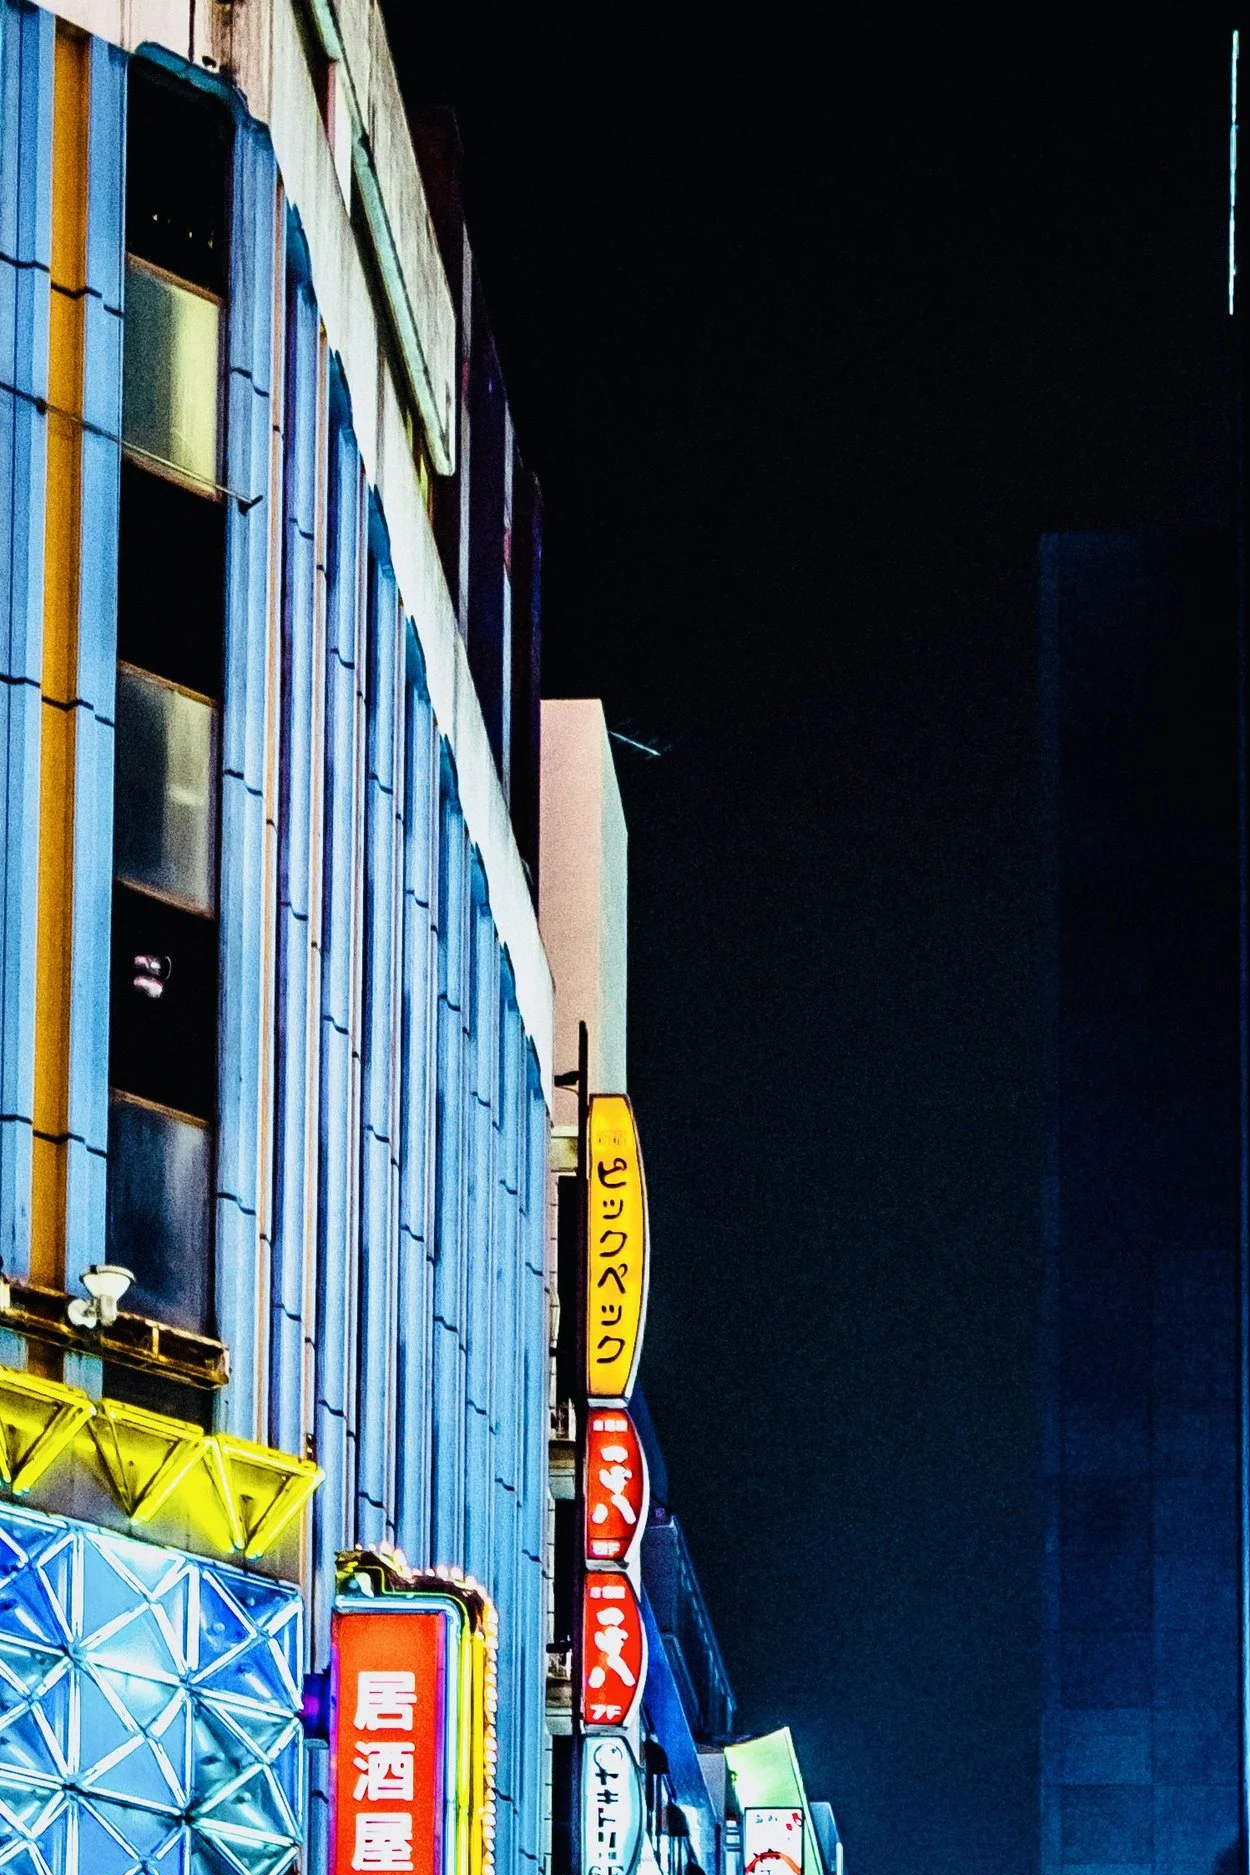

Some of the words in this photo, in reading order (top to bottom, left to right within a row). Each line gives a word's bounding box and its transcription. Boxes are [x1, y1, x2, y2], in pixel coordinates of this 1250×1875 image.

[596, 1157, 629, 1364] ピックペック
[351, 1671, 415, 1873] 居酒屋
[589, 1704, 622, 1722] 7F
